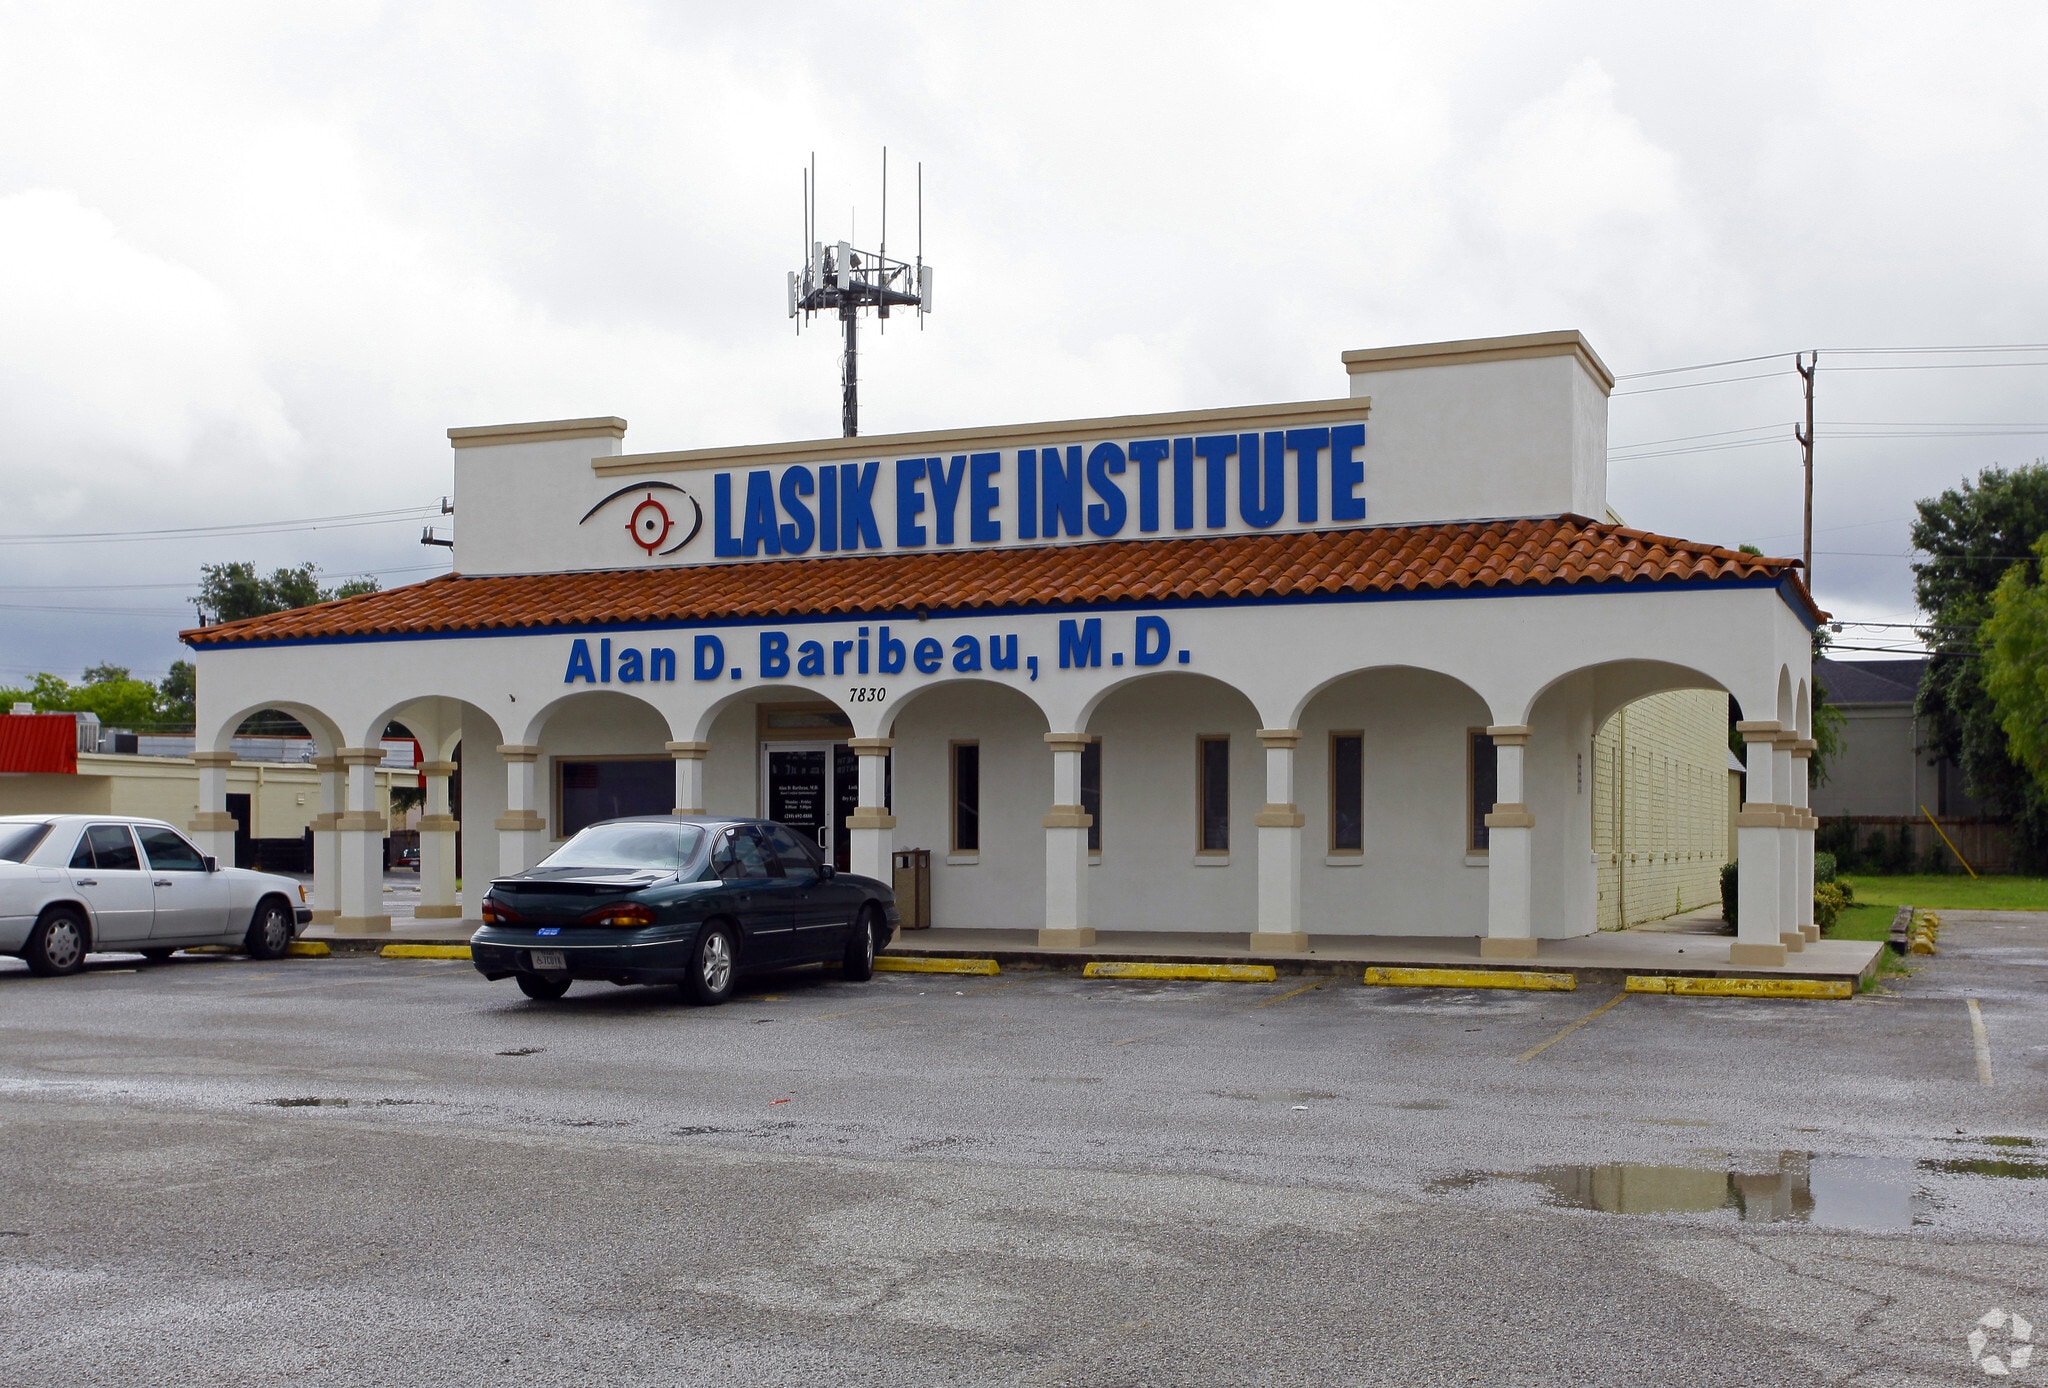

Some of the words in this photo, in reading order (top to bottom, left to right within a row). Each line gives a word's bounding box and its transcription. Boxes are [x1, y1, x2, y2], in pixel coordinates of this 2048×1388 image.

[714, 461, 883, 558] LASIK
[896, 451, 1001, 547] EYE
[1017, 423, 1366, 539] INSTITUTE
[563, 632, 676, 684] Alan
[693, 633, 742, 682] D.
[759, 626, 1039, 683] Baribeau,
[1058, 615, 1192, 669] M.D.
[849, 687, 886, 703] 7830
